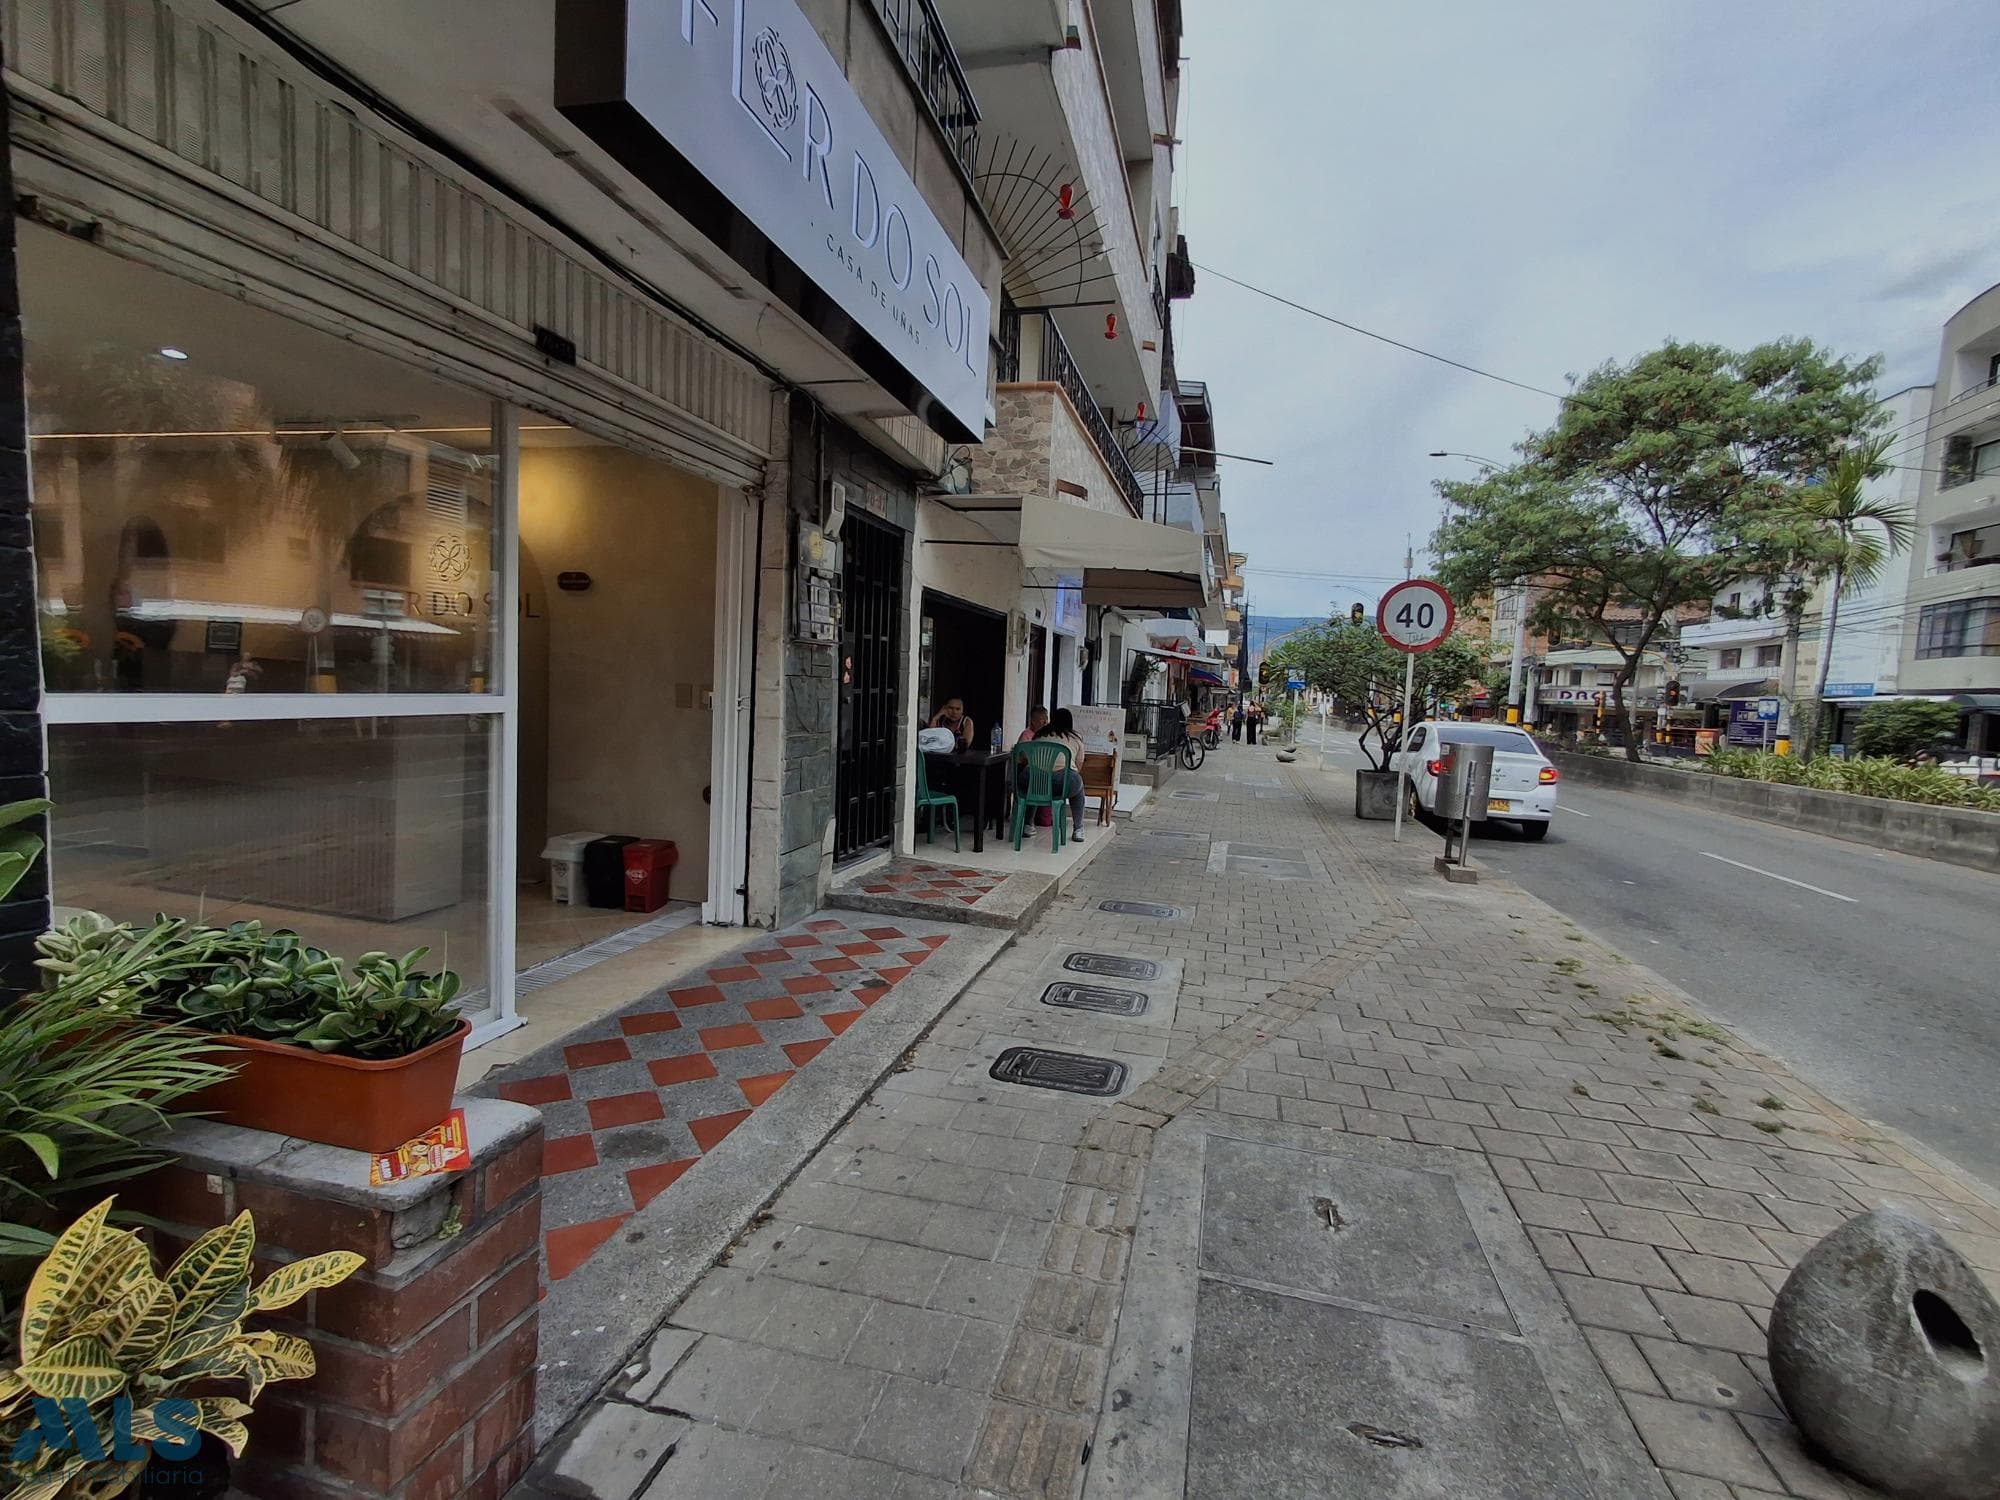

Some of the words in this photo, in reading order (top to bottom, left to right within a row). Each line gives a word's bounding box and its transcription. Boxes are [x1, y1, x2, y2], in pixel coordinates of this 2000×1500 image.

[826, 233, 863, 284] CASA
[870, 280, 887, 309] DE
[893, 306, 921, 346] UÑAS
[923, 252, 977, 378] SOL
[1395, 602, 1434, 629] 40
